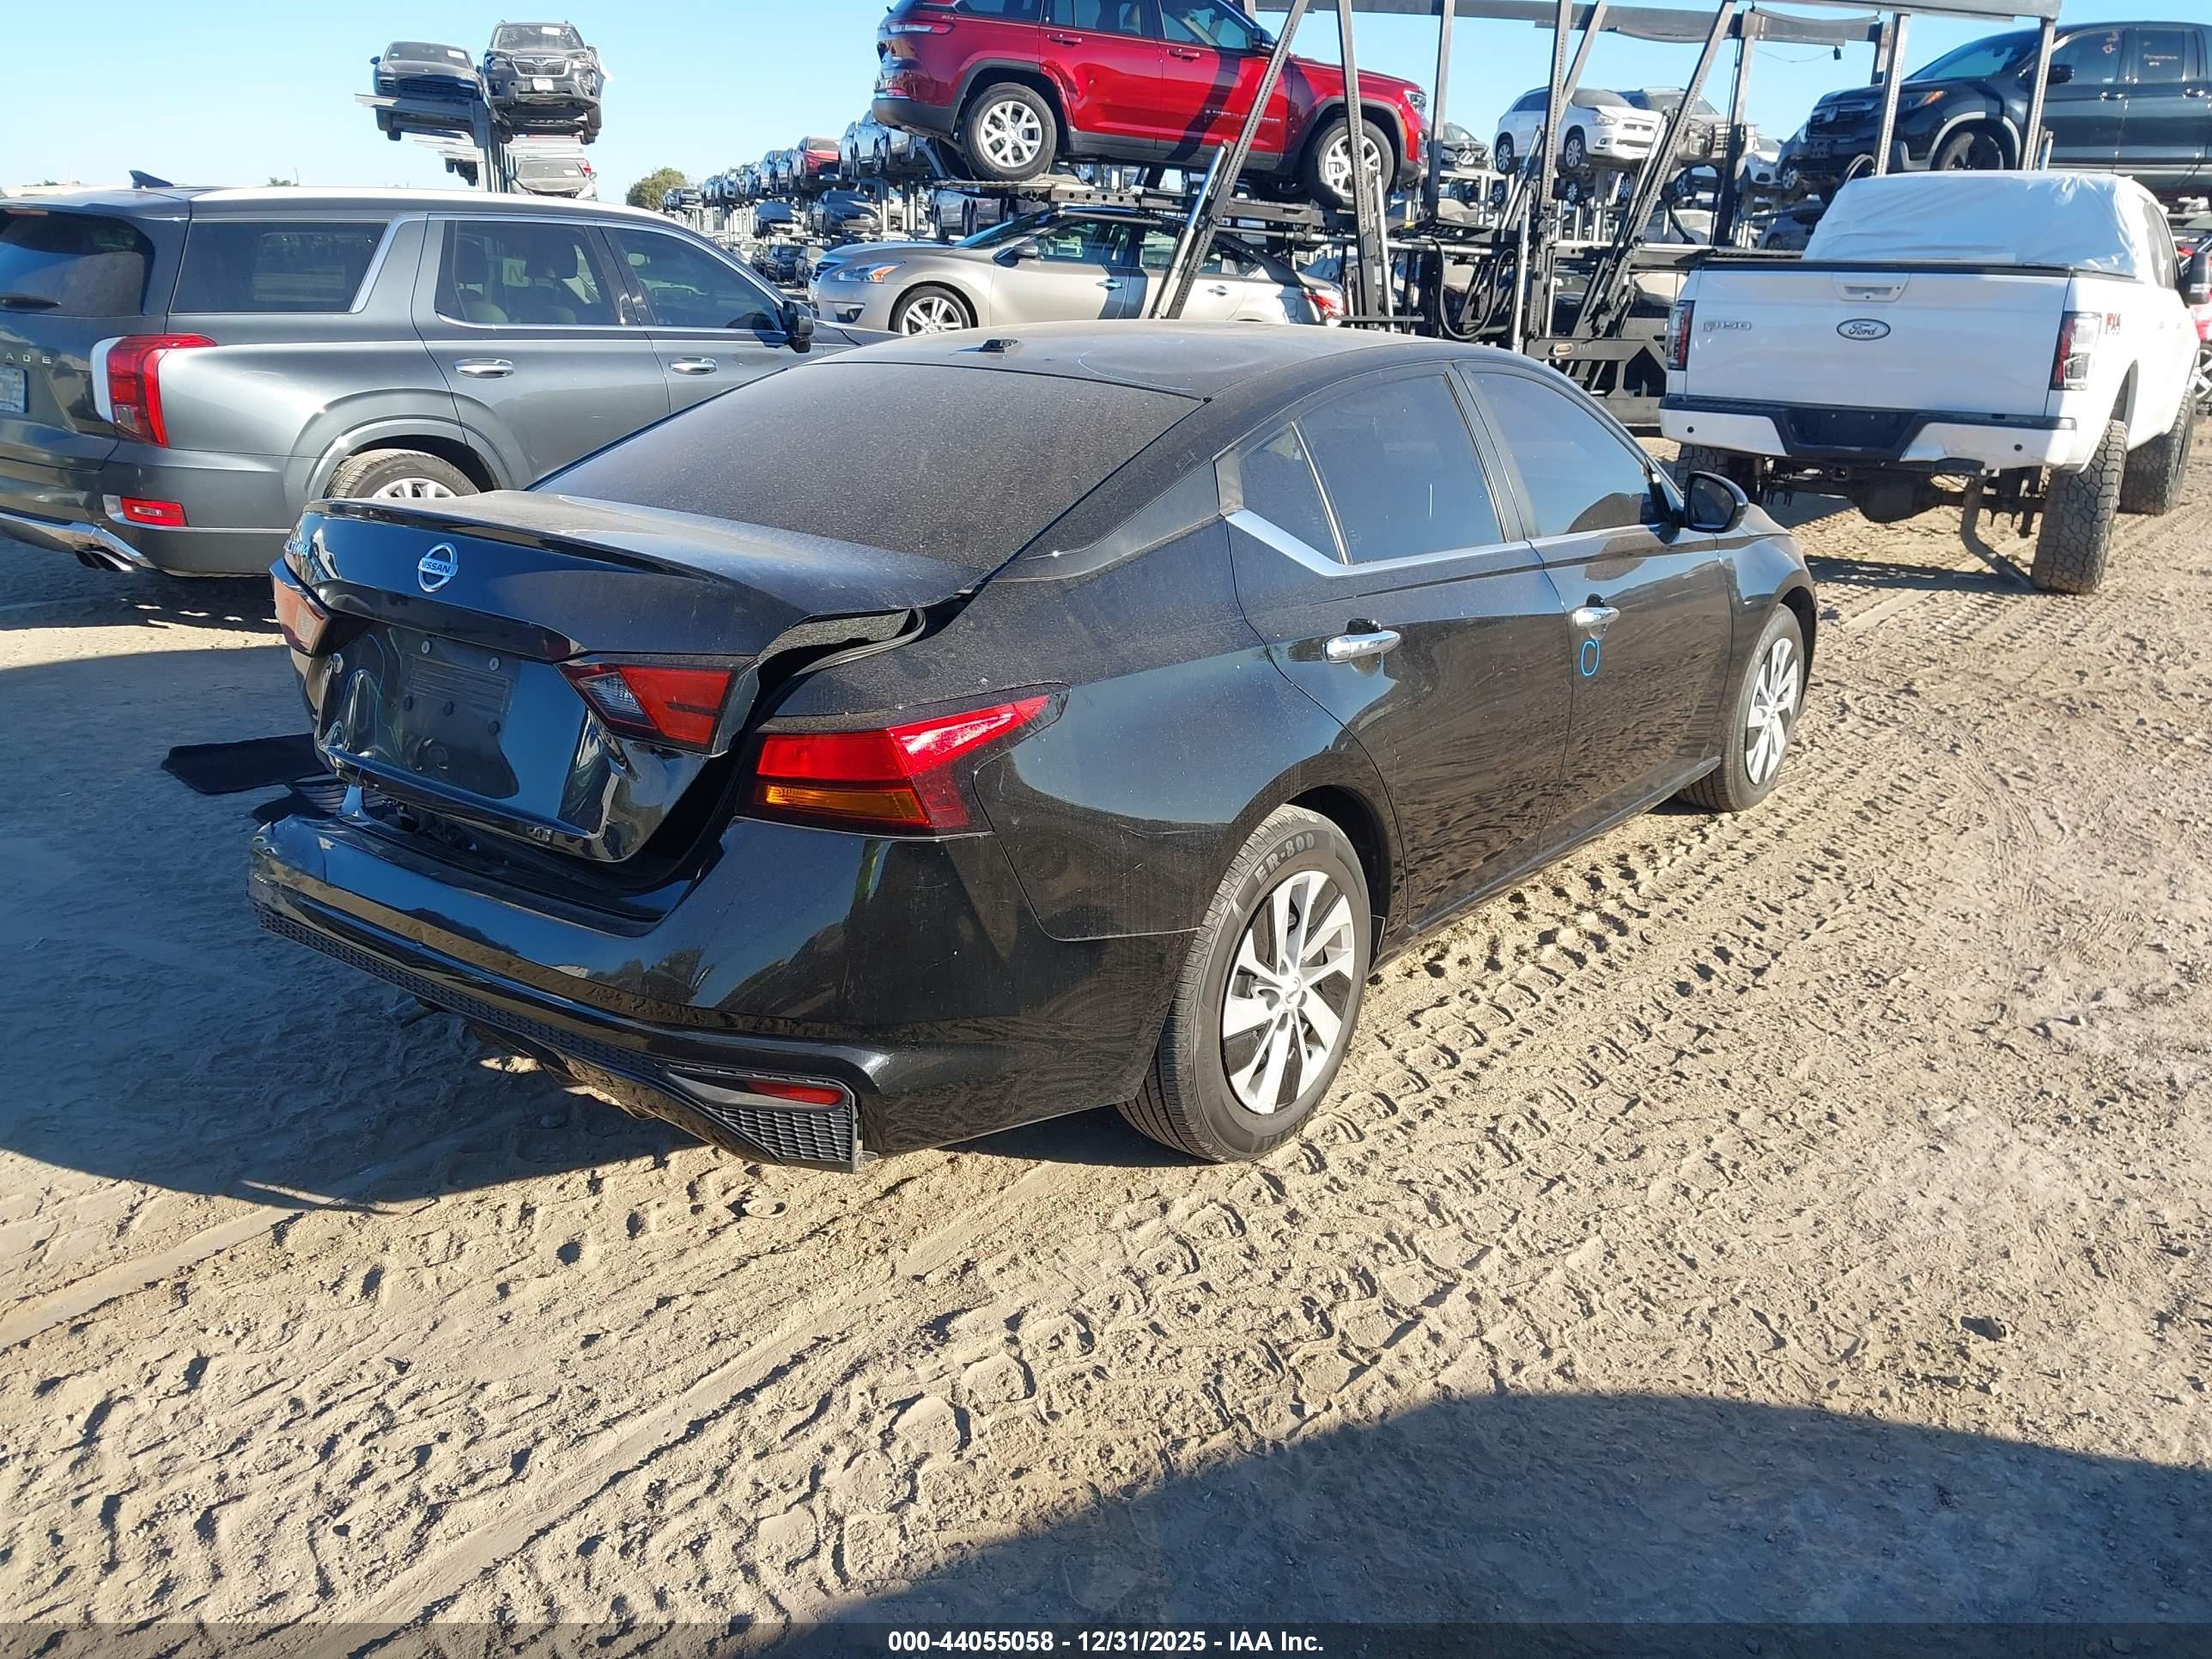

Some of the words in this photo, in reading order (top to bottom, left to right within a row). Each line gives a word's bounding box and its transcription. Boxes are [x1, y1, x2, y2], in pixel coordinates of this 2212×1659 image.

[1848, 323, 1877, 337] Ford
[422, 560, 452, 574] NISSAN
[1254, 832, 1315, 886] ER-800
